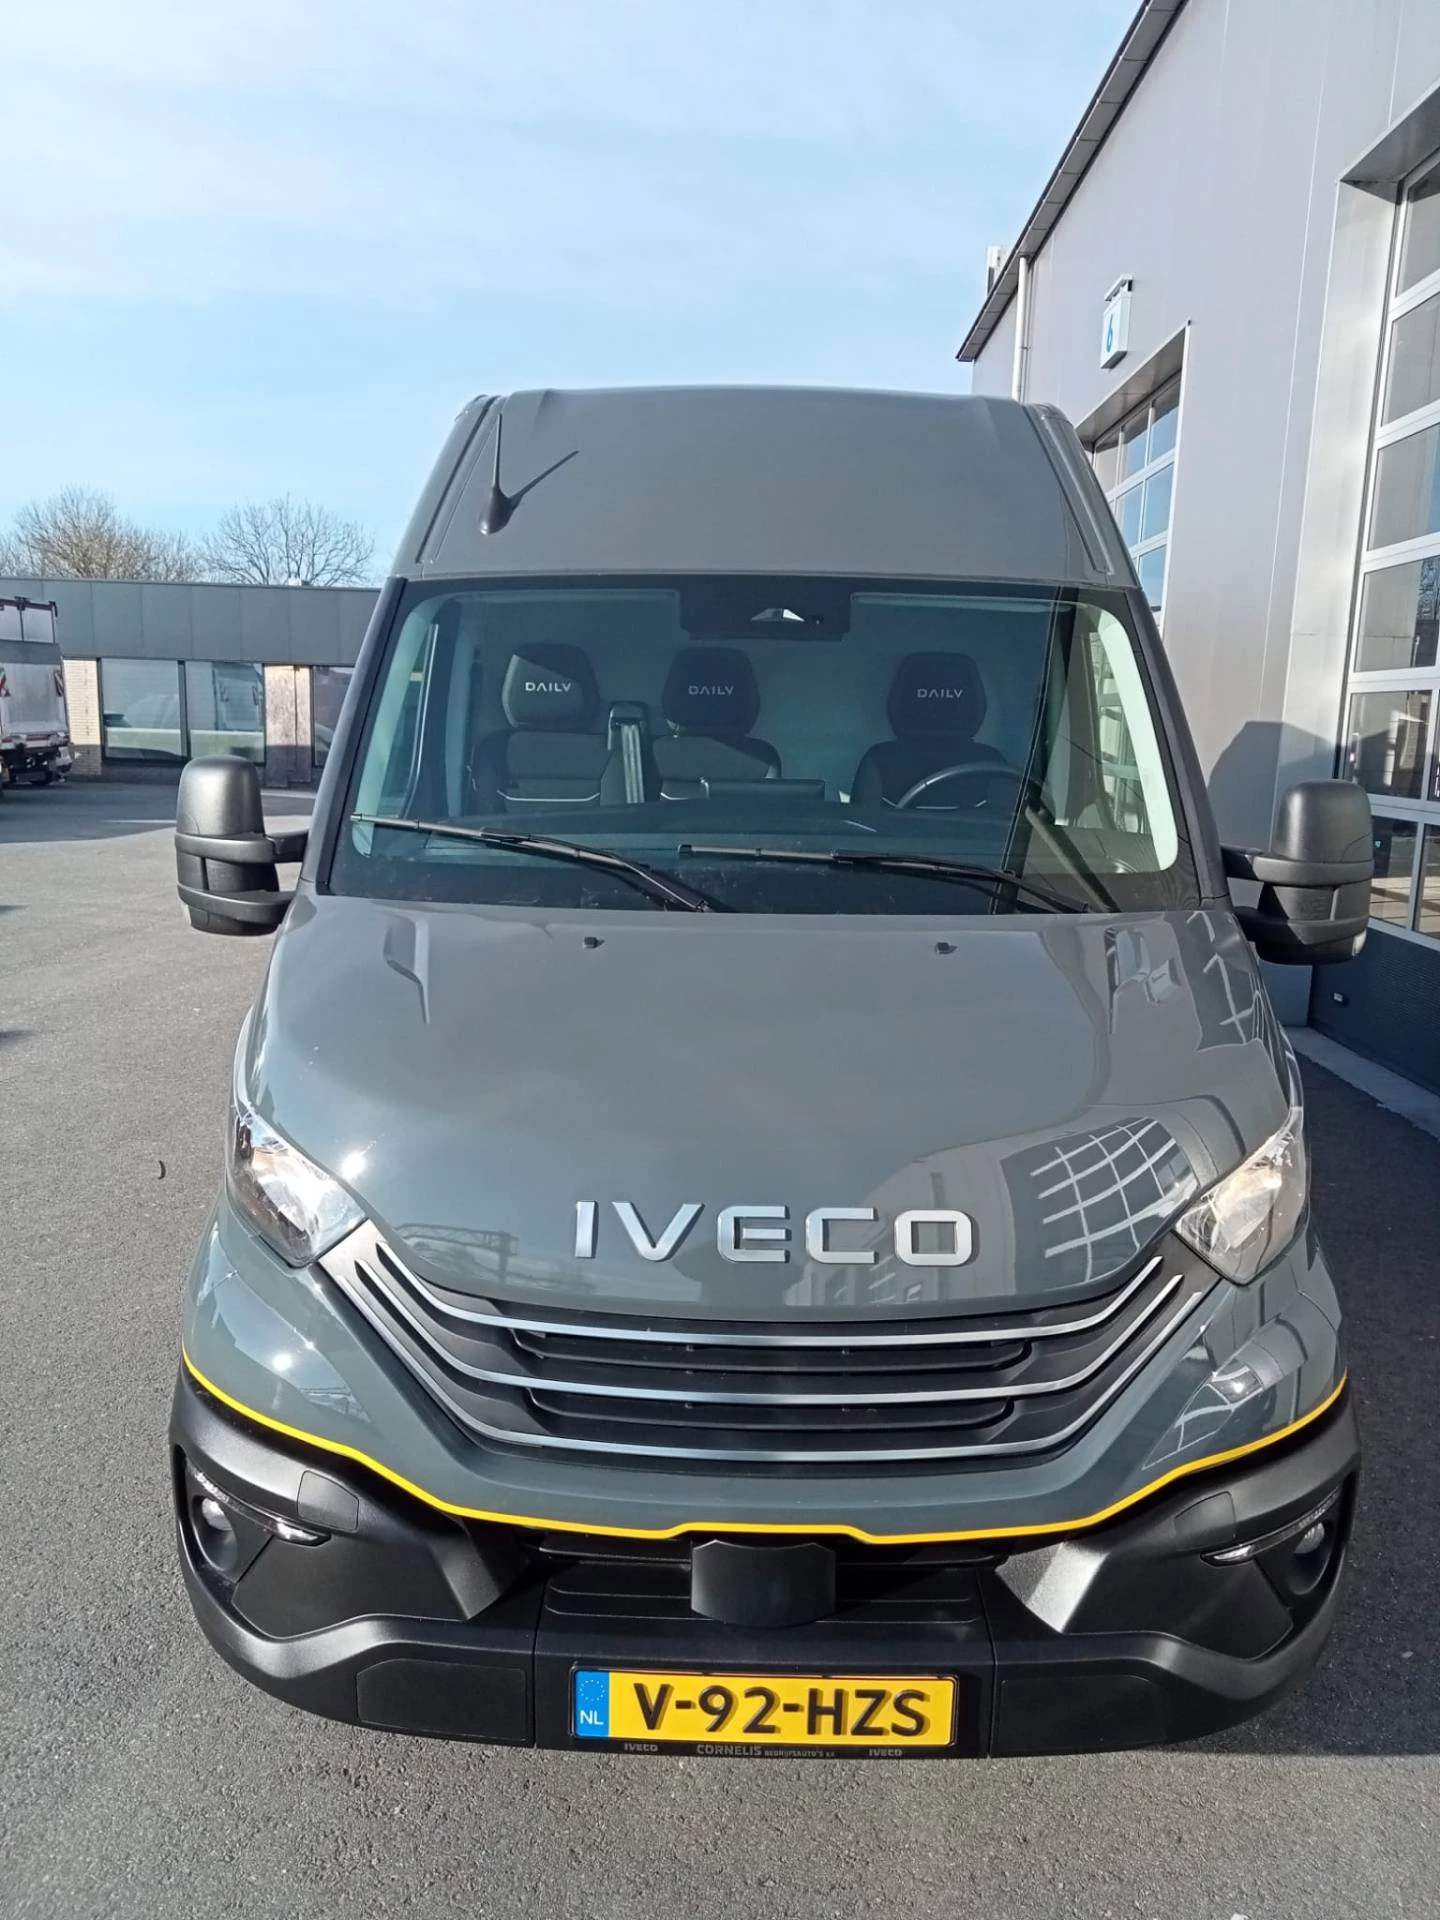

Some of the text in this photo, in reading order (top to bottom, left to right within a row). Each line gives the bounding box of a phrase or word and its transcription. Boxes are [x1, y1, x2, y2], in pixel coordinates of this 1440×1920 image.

[1106, 313, 1113, 352] 6
[525, 682, 572, 693] DAILY
[688, 684, 735, 696] DAILY
[916, 687, 963, 699] DAILY
[574, 1200, 975, 1267] IVECO
[633, 1682, 931, 1737] V-92-HZS
[580, 1710, 604, 1726] NL
[623, 1743, 659, 1752] IVECO
[696, 1744, 762, 1757] CORNELIS
[868, 1748, 903, 1757] IVECO
